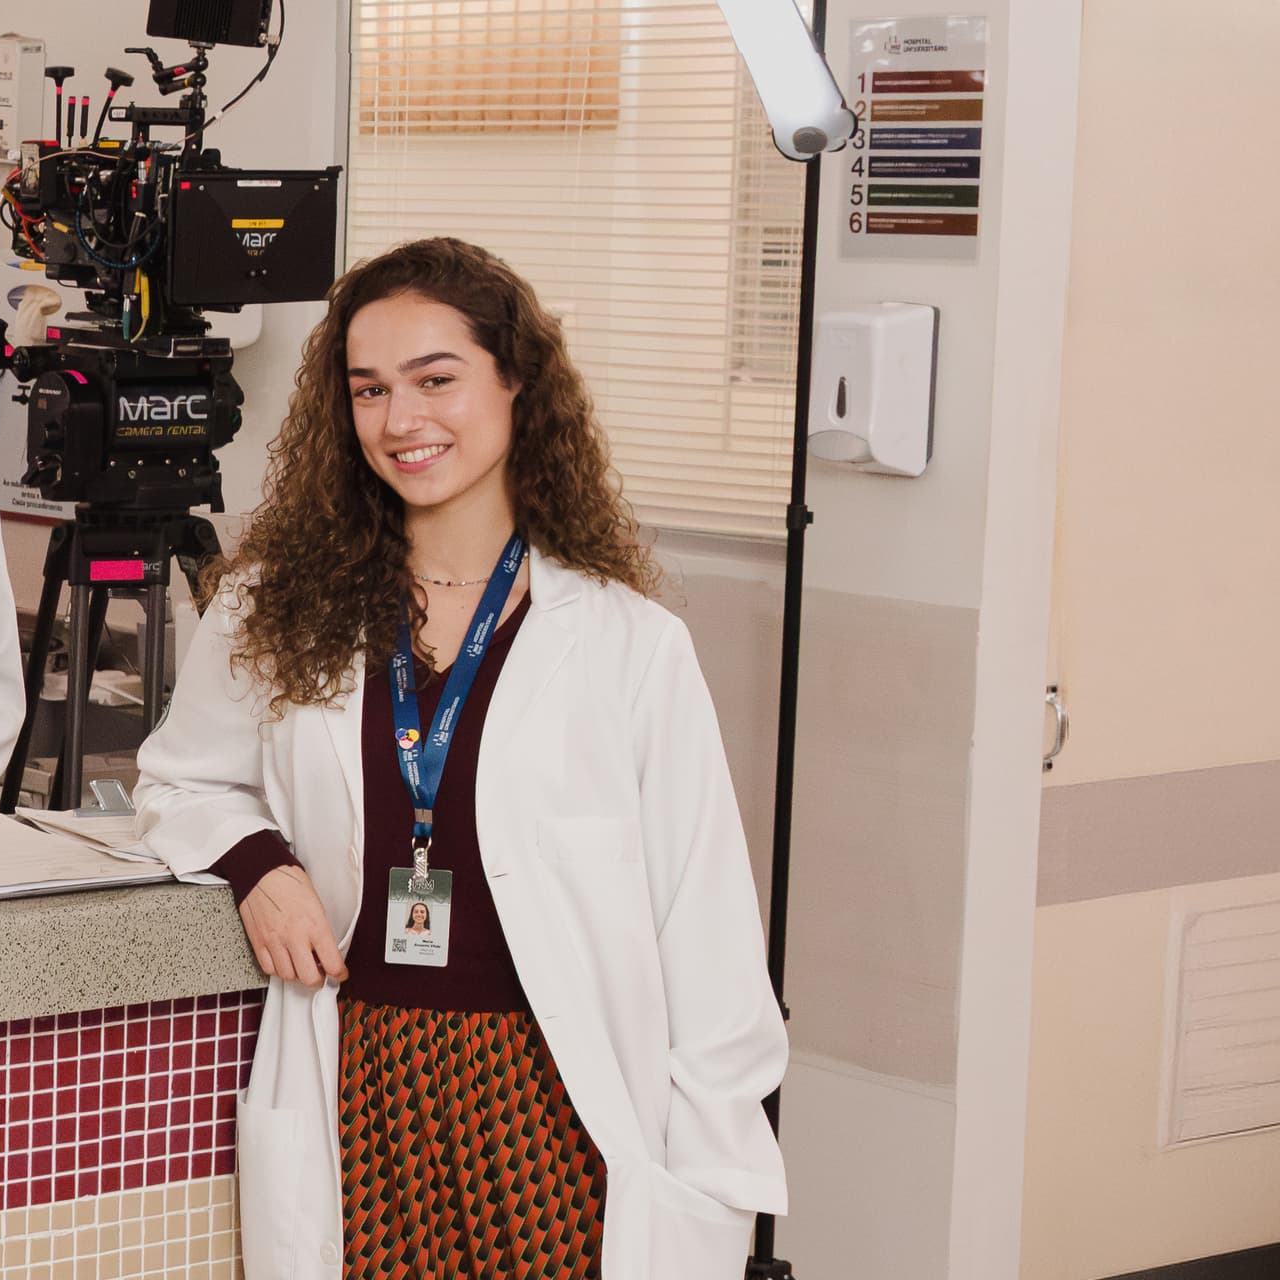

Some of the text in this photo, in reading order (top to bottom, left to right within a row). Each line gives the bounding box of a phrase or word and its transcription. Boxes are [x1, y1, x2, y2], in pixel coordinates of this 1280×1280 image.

[857, 73, 866, 93] 1
[855, 101, 866, 121] 2
[853, 128, 866, 150] 3
[851, 156, 865, 177] 4
[850, 185, 863, 206] 5
[849, 212, 862, 233] 6
